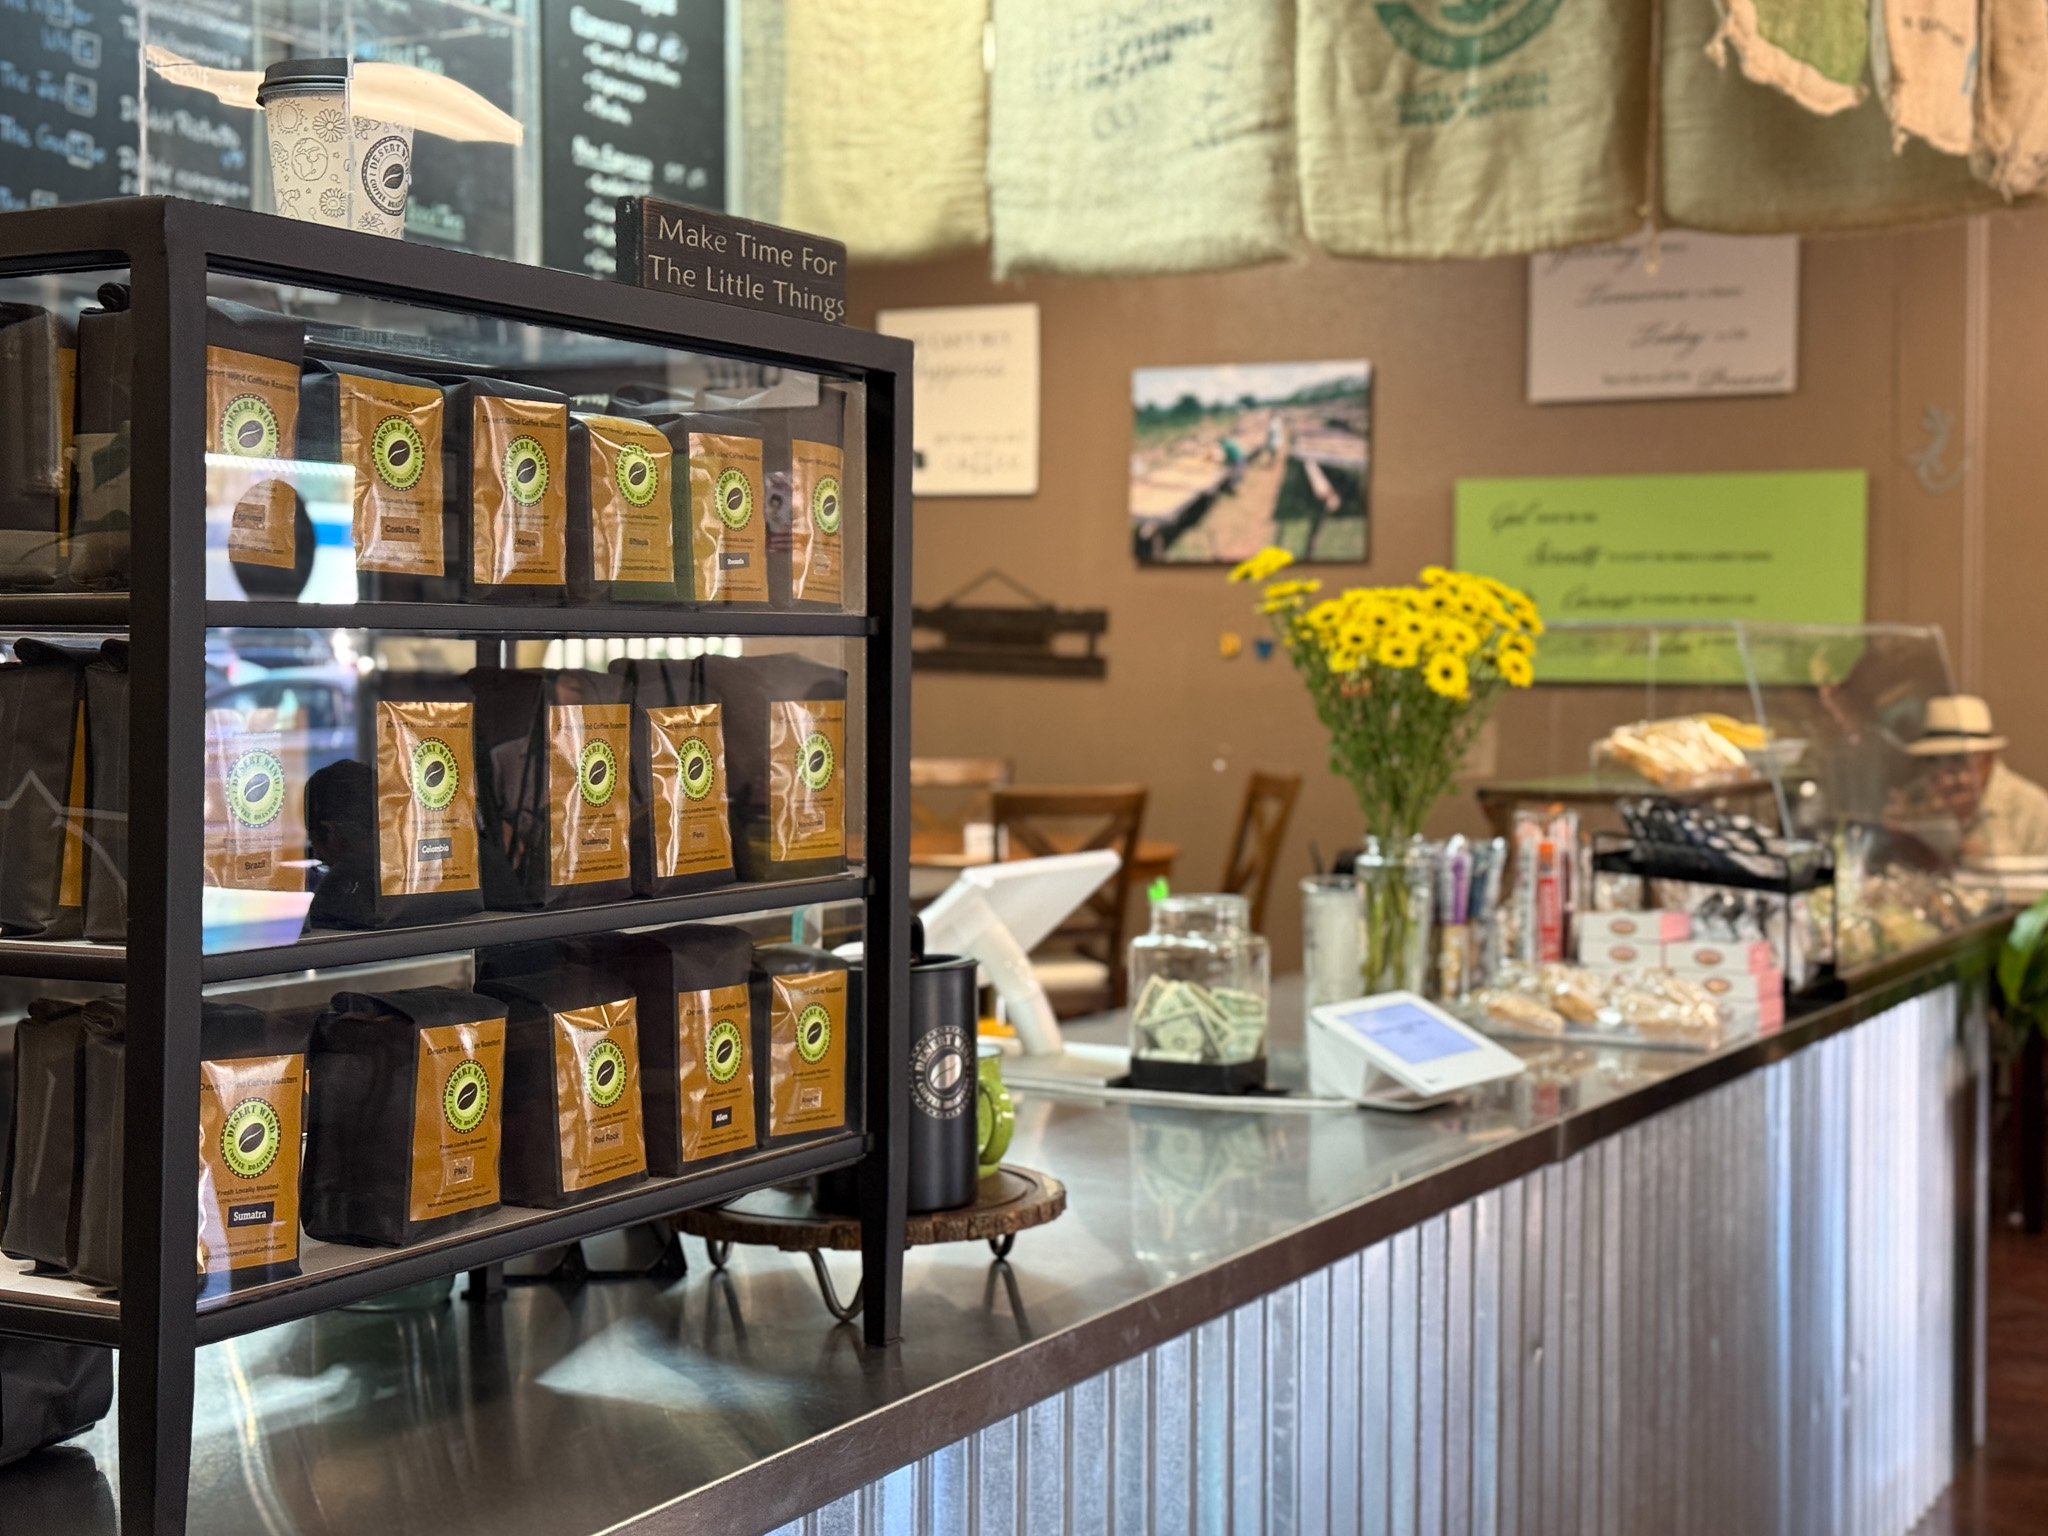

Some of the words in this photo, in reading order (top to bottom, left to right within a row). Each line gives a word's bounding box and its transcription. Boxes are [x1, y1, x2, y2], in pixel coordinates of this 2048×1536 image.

[369, 143, 401, 170] DESERT
[659, 215, 728, 253] Make
[735, 231, 794, 268] Time
[801, 246, 838, 277] For
[648, 254, 697, 288] The
[706, 266, 765, 301] Little
[772, 280, 845, 322] Things
[247, 374, 270, 387] Coffee
[226, 400, 256, 429] DESERT
[258, 407, 275, 436] WIND
[376, 422, 402, 449] DESERT
[404, 426, 421, 454] WIND
[531, 445, 546, 470] WIND
[718, 473, 738, 497] DESERT
[385, 524, 404, 534] Costa
[405, 525, 420, 535] Rica
[518, 538, 536, 547] Kenya
[439, 746, 455, 772] WIND
[581, 745, 601, 772] DESERT
[681, 742, 697, 768] DESERT
[231, 755, 262, 787] DESERT
[263, 758, 281, 786] WIND
[421, 844, 450, 854] Colombia
[244, 859, 266, 871] Brazil
[800, 1008, 817, 1033] DESERT
[708, 1024, 728, 1052] DESERT
[729, 1026, 740, 1048] WIND
[587, 1044, 607, 1075] DESERT
[609, 1046, 623, 1068] WIND
[914, 1033, 952, 1072] DESERT
[247, 1079, 271, 1088] Coffee
[271, 1076, 298, 1086] Roasters
[447, 1066, 472, 1097] DESERT
[473, 1068, 486, 1092] WIND
[226, 1104, 257, 1139] DESERT
[259, 1106, 277, 1133] WIND
[593, 1134, 605, 1144] Red
[606, 1132, 620, 1141] Rock
[228, 1148, 246, 1171] COFFEE
[247, 1146, 274, 1171] ROASTERS
[454, 1166, 468, 1176] PNG
[235, 1187, 255, 1195] Locally
[256, 1183, 279, 1192] Roasted
[233, 1210, 267, 1221] Sumatra
